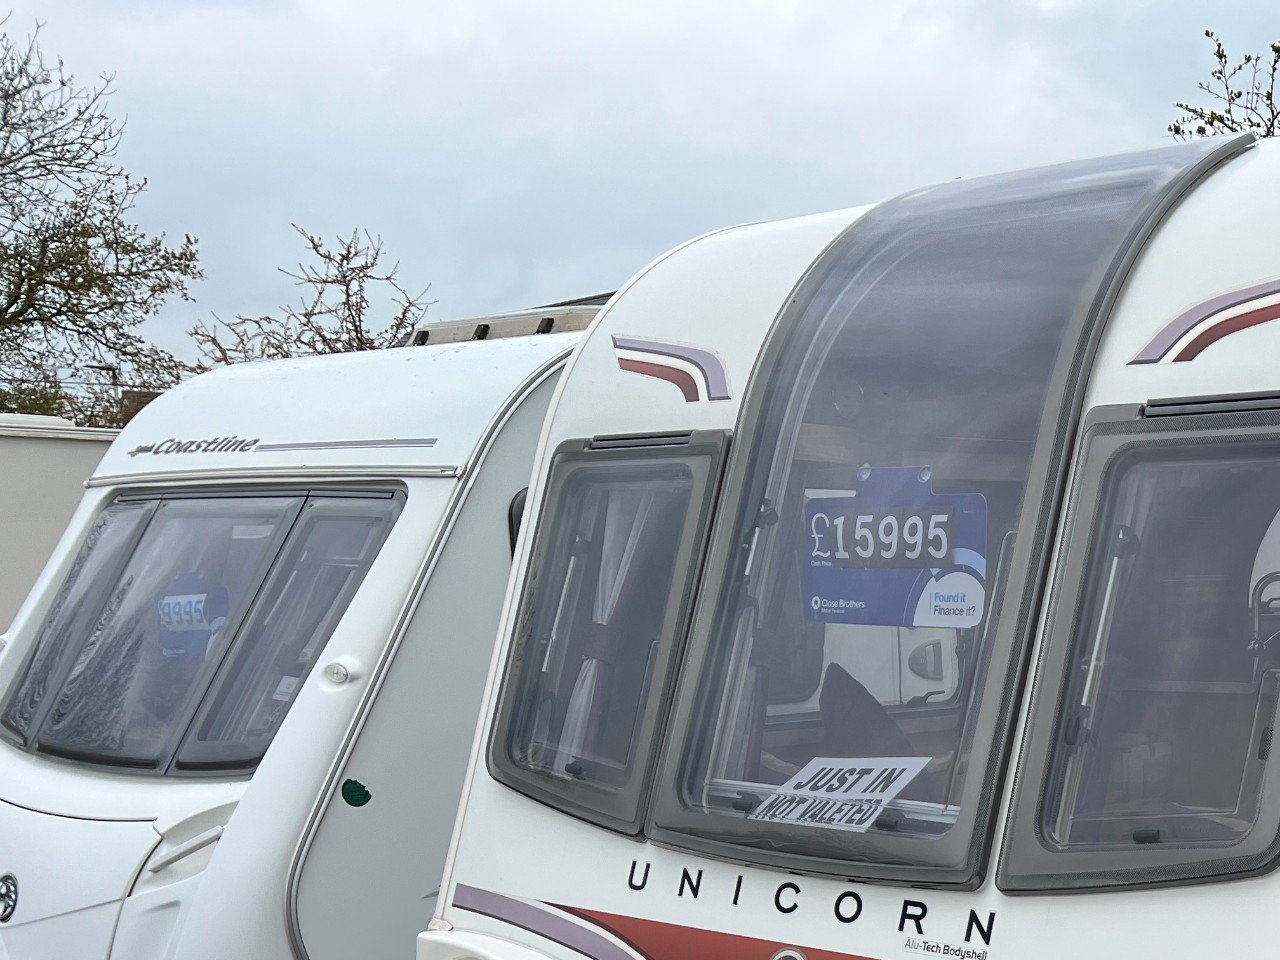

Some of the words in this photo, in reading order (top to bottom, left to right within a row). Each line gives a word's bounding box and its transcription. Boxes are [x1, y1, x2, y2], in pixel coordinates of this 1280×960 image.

[152, 436, 260, 456] Coastline
[811, 513, 949, 559] £15995
[821, 598, 838, 608] Close
[839, 599, 865, 608] Brothers
[934, 592, 958, 603] Found
[959, 592, 966, 603] it
[933, 605, 963, 616] Finance
[965, 605, 976, 617] it?
[793, 767, 874, 793] JUST
[861, 767, 908, 794] IN
[755, 793, 806, 820] NOT
[796, 797, 883, 826] VALETED
[628, 860, 996, 946] UNICORN
[904, 938, 941, 953] Alu-Tech
[942, 944, 988, 960] Bodyshell
